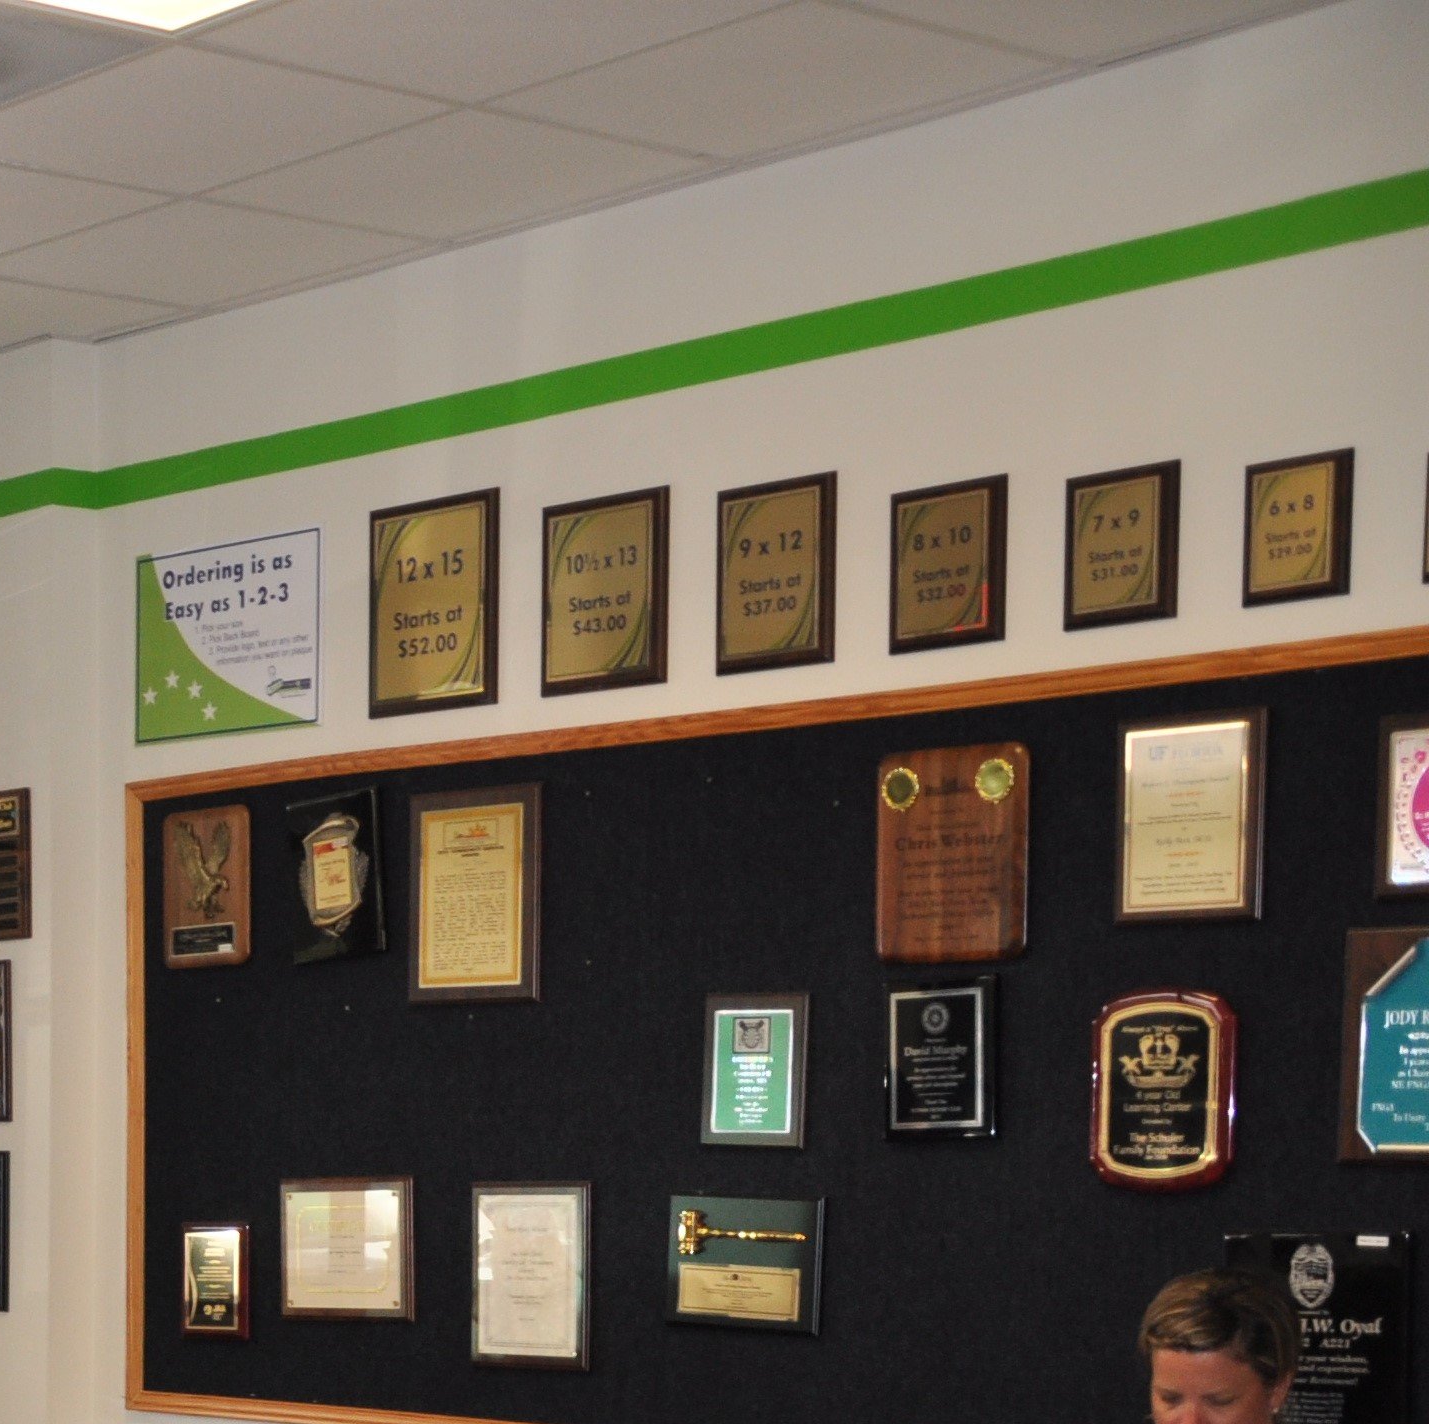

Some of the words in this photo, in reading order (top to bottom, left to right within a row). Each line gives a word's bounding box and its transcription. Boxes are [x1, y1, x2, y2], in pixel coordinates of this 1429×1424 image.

[1269, 498, 1281, 517] 6
[1286, 501, 1298, 515] x
[1303, 494, 1315, 512] 8
[1093, 513, 1103, 533] 7
[1111, 516, 1123, 530] x
[1128, 508, 1140, 528] 9
[739, 535, 751, 559] 9
[758, 540, 770, 555] x
[777, 529, 803, 552] 12
[913, 529, 925, 552] 8
[931, 534, 942, 549] x
[949, 525, 973, 546] 10
[1265, 529, 1301, 546] Starts
[1303, 527, 1317, 541] at
[395, 557, 416, 583] 12
[422, 561, 435, 580] x
[442, 549, 464, 575] 15
[603, 555, 613, 569] x
[618, 545, 638, 568] 13
[1088, 548, 1127, 565] Starts
[1129, 546, 1143, 560] at
[161, 558, 245, 592] Ordering
[250, 556, 267, 578] is
[272, 553, 293, 573] as
[913, 567, 954, 585] Starts
[956, 565, 971, 580] at
[1090, 563, 1139, 582] $31.00
[738, 576, 785, 596] Starts
[787, 574, 802, 591] at
[916, 584, 967, 604] $32.00
[164, 594, 205, 622] Easy
[210, 593, 232, 614] as
[237, 583, 290, 609] 1-2-3
[568, 594, 611, 614] Starts
[615, 590, 631, 608] at
[742, 595, 798, 617] $37.00
[393, 607, 440, 632] Starts
[445, 605, 463, 625] at
[572, 613, 627, 637] $43.00
[397, 634, 457, 659] $52.00
[1383, 1009, 1419, 1030] JODY
